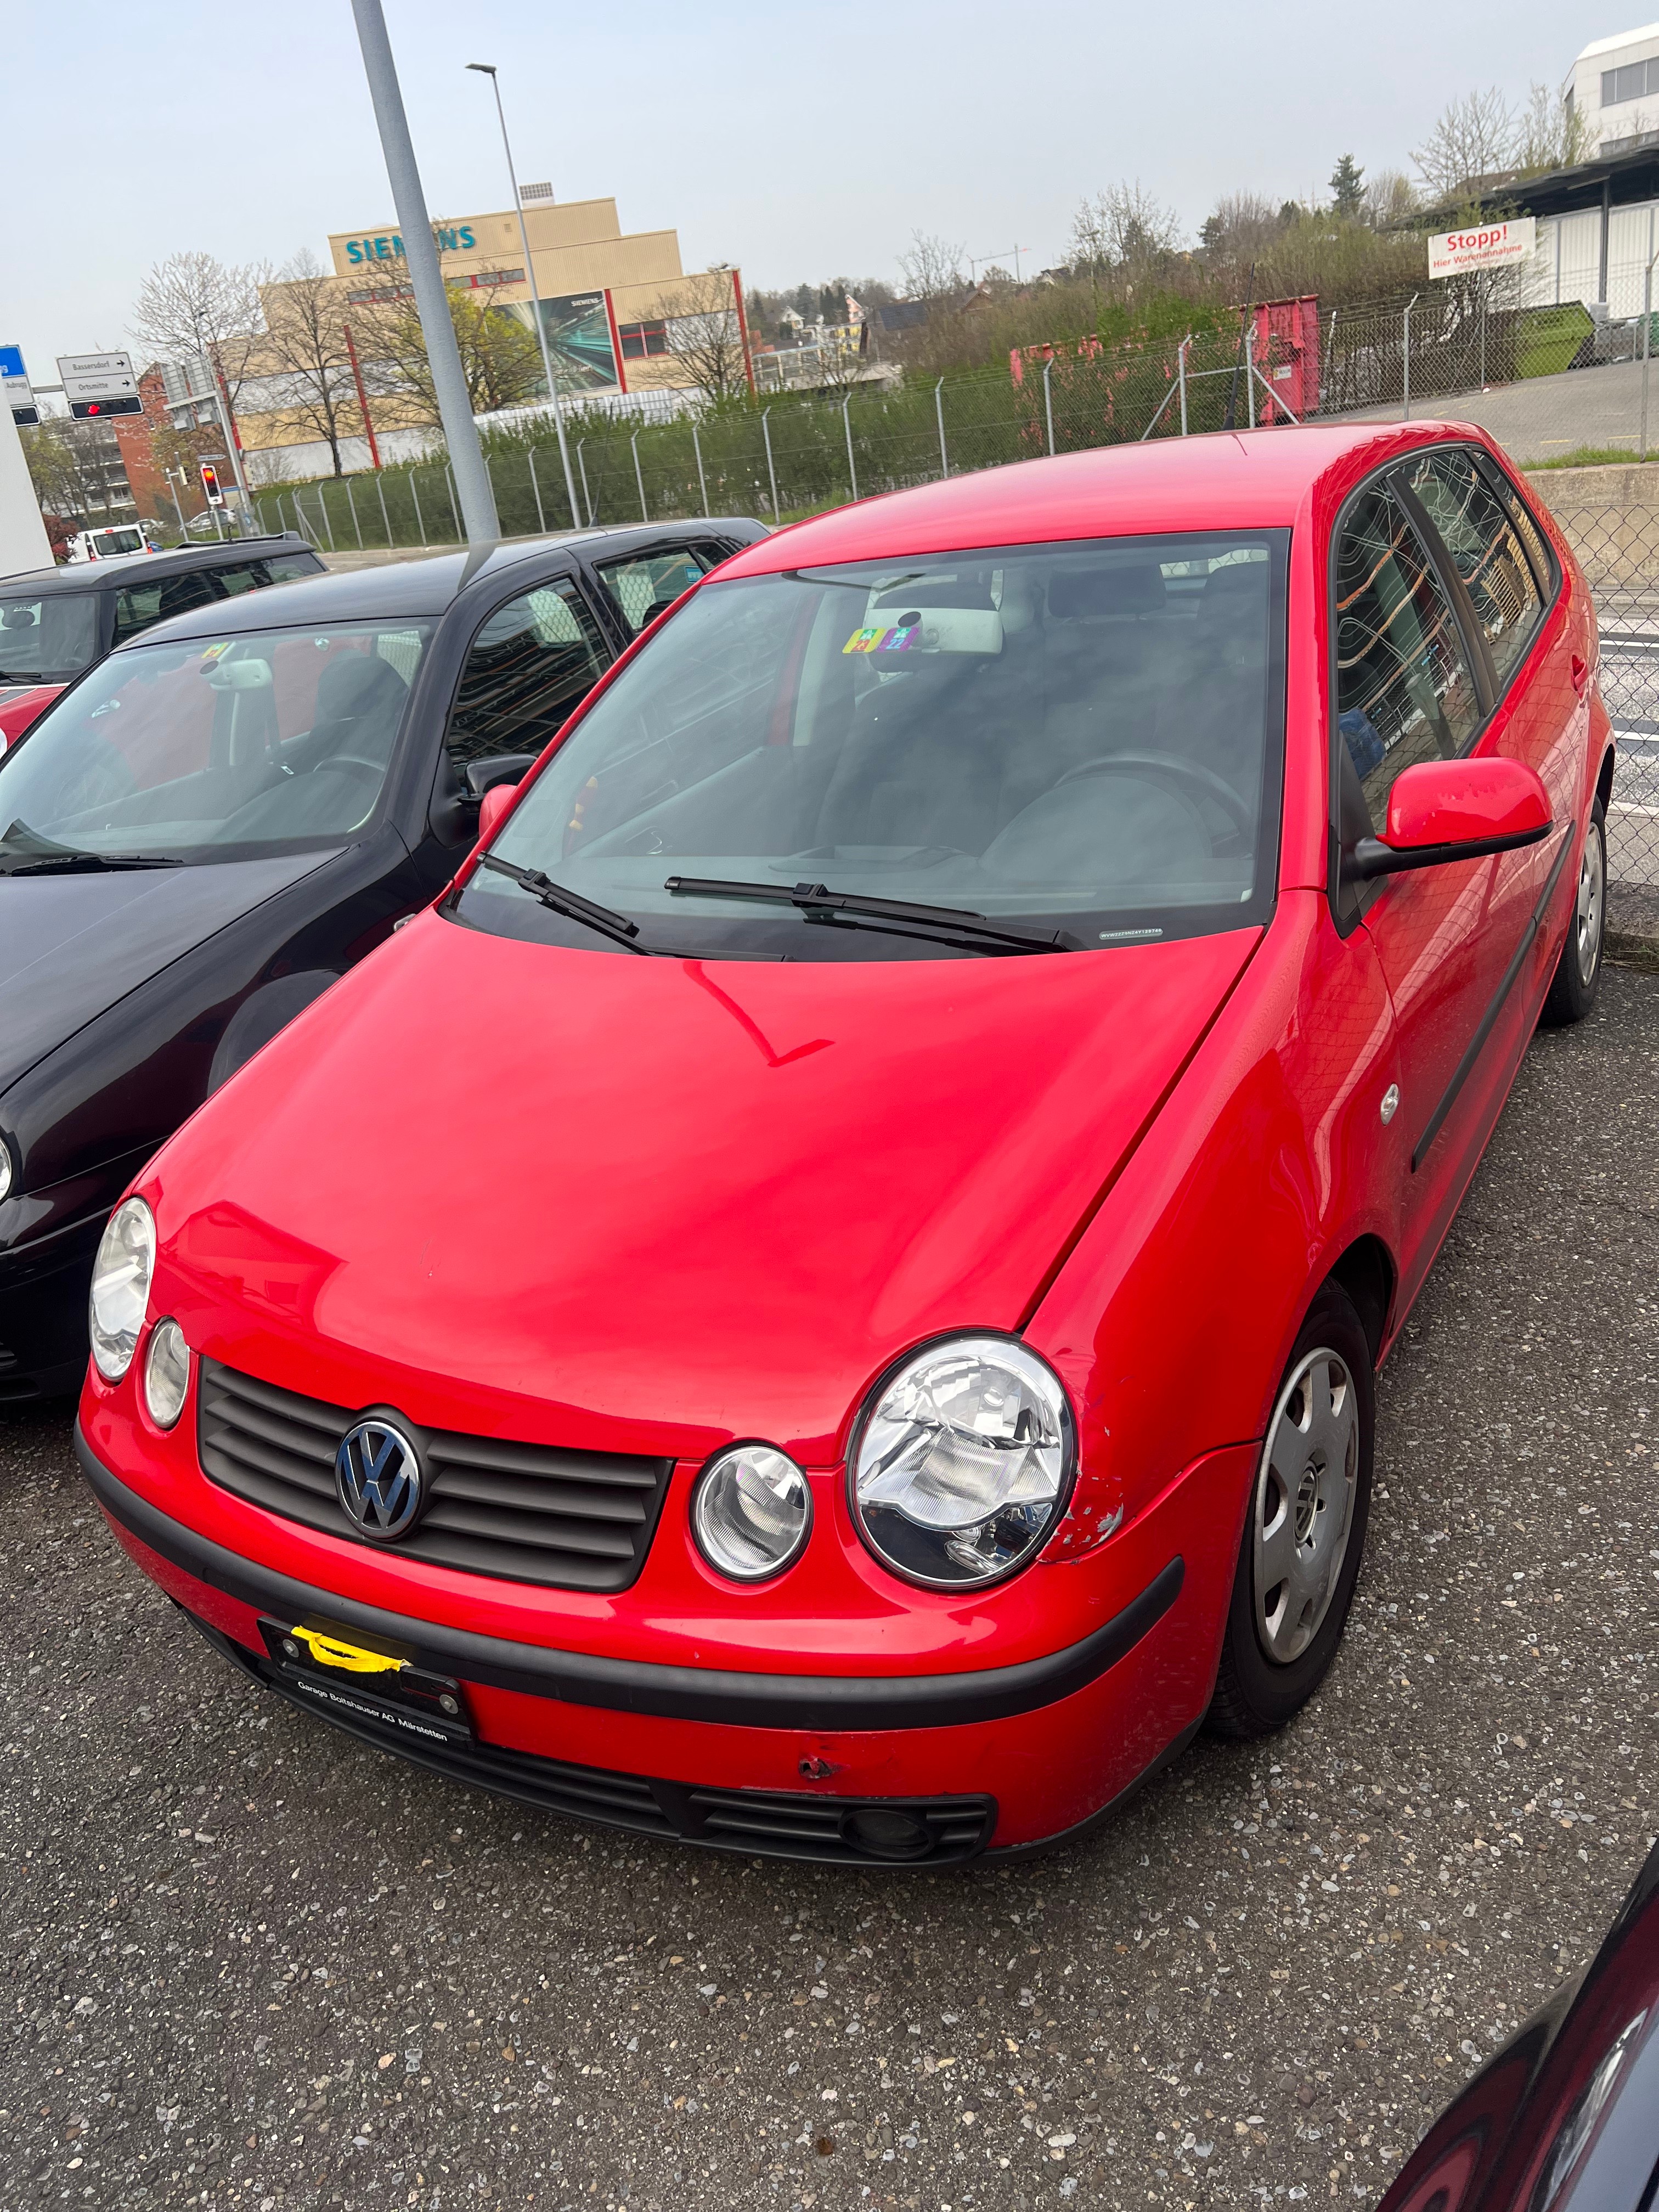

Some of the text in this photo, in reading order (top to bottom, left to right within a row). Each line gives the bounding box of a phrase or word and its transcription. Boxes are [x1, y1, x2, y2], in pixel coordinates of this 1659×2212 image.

[346, 225, 476, 263] SIENS
[1447, 224, 1507, 252] Stopp!
[1433, 258, 1452, 268] Hier
[1453, 244, 1523, 264] Warenannahme
[571, 297, 599, 307] SIEMENS
[72, 360, 110, 370] Bassersdorf
[78, 382, 109, 391] Ortsmitte
[885, 637, 905, 650] 22
[297, 1681, 448, 1742] Garage Boltshauser AG Märstetten
